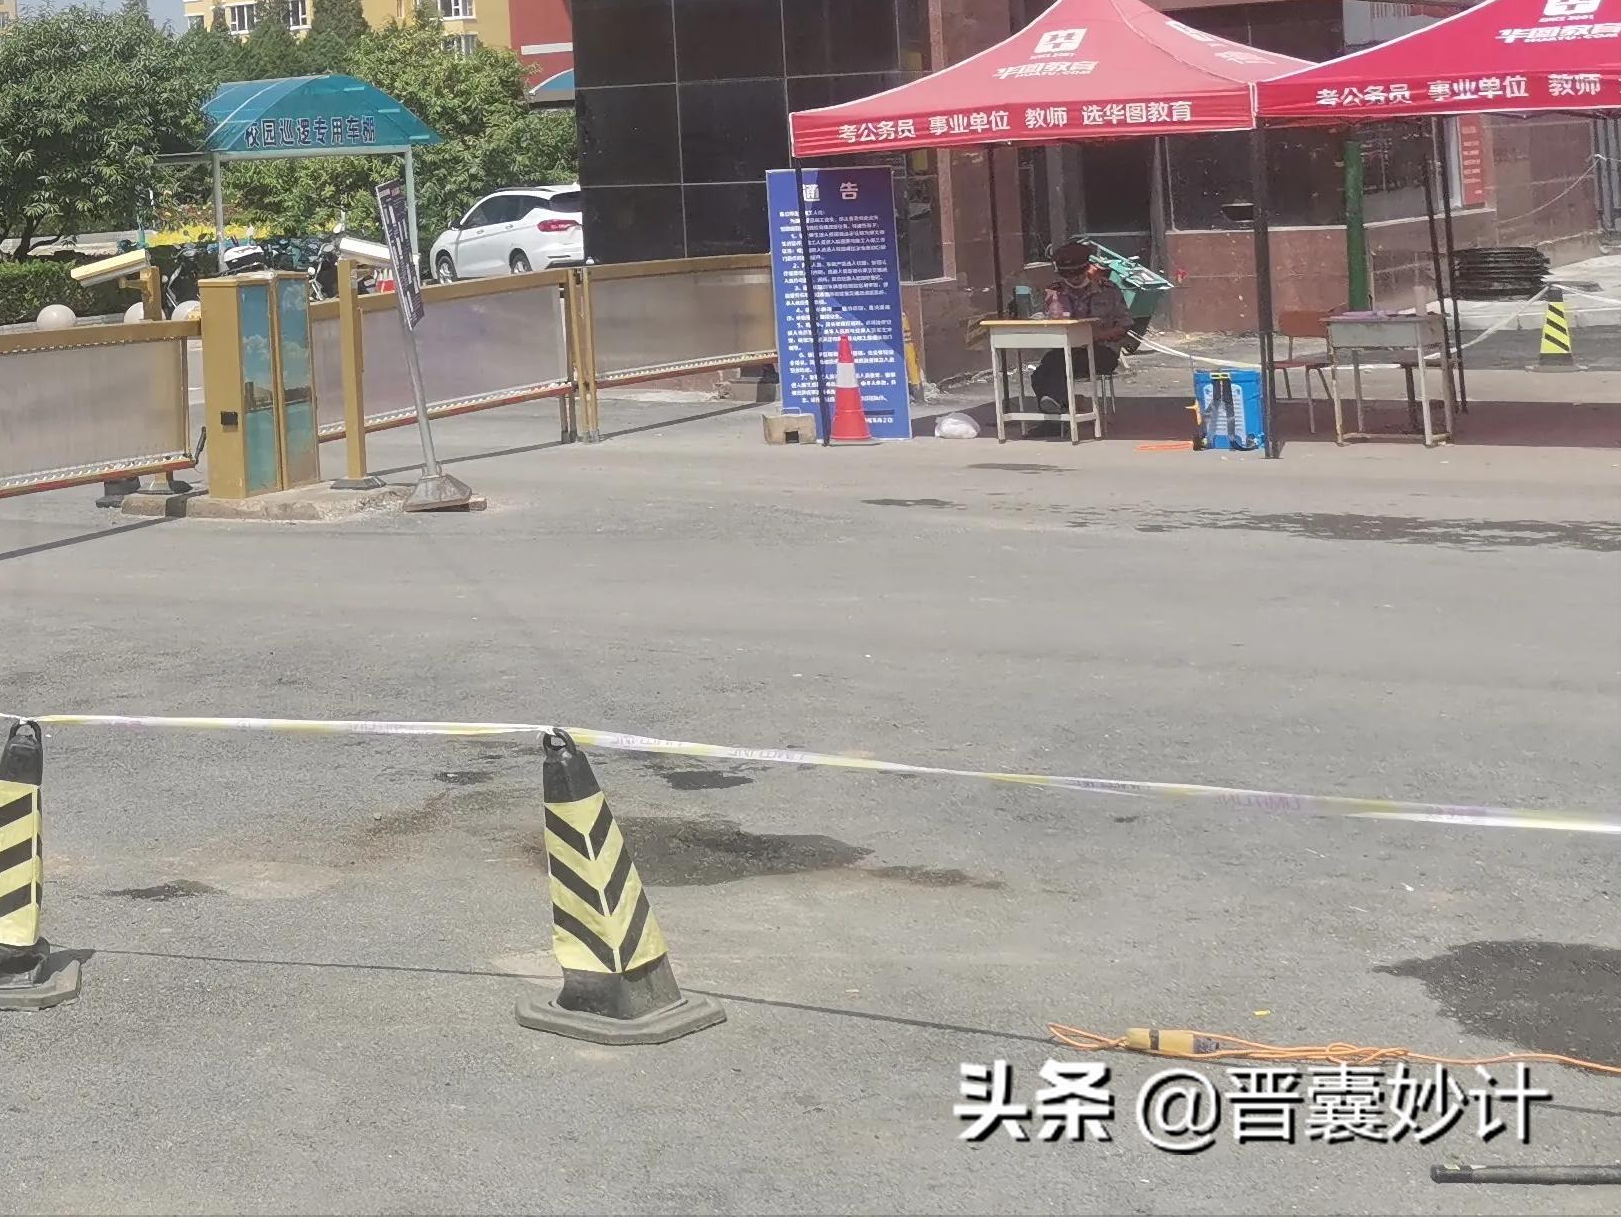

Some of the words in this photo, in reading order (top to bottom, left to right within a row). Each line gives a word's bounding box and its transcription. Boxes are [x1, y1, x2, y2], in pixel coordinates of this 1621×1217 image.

[1316, 84, 1412, 108] 考公务员
[1427, 74, 1529, 102] 事业单位
[1547, 74, 1602, 96] 教师
[244, 114, 376, 149] 校园巡逻专用车棚
[837, 118, 916, 143] 考公务员
[928, 110, 1010, 136] 事业单位
[1025, 107, 1068, 128] 教师
[1081, 101, 1193, 125] 选华图教育
